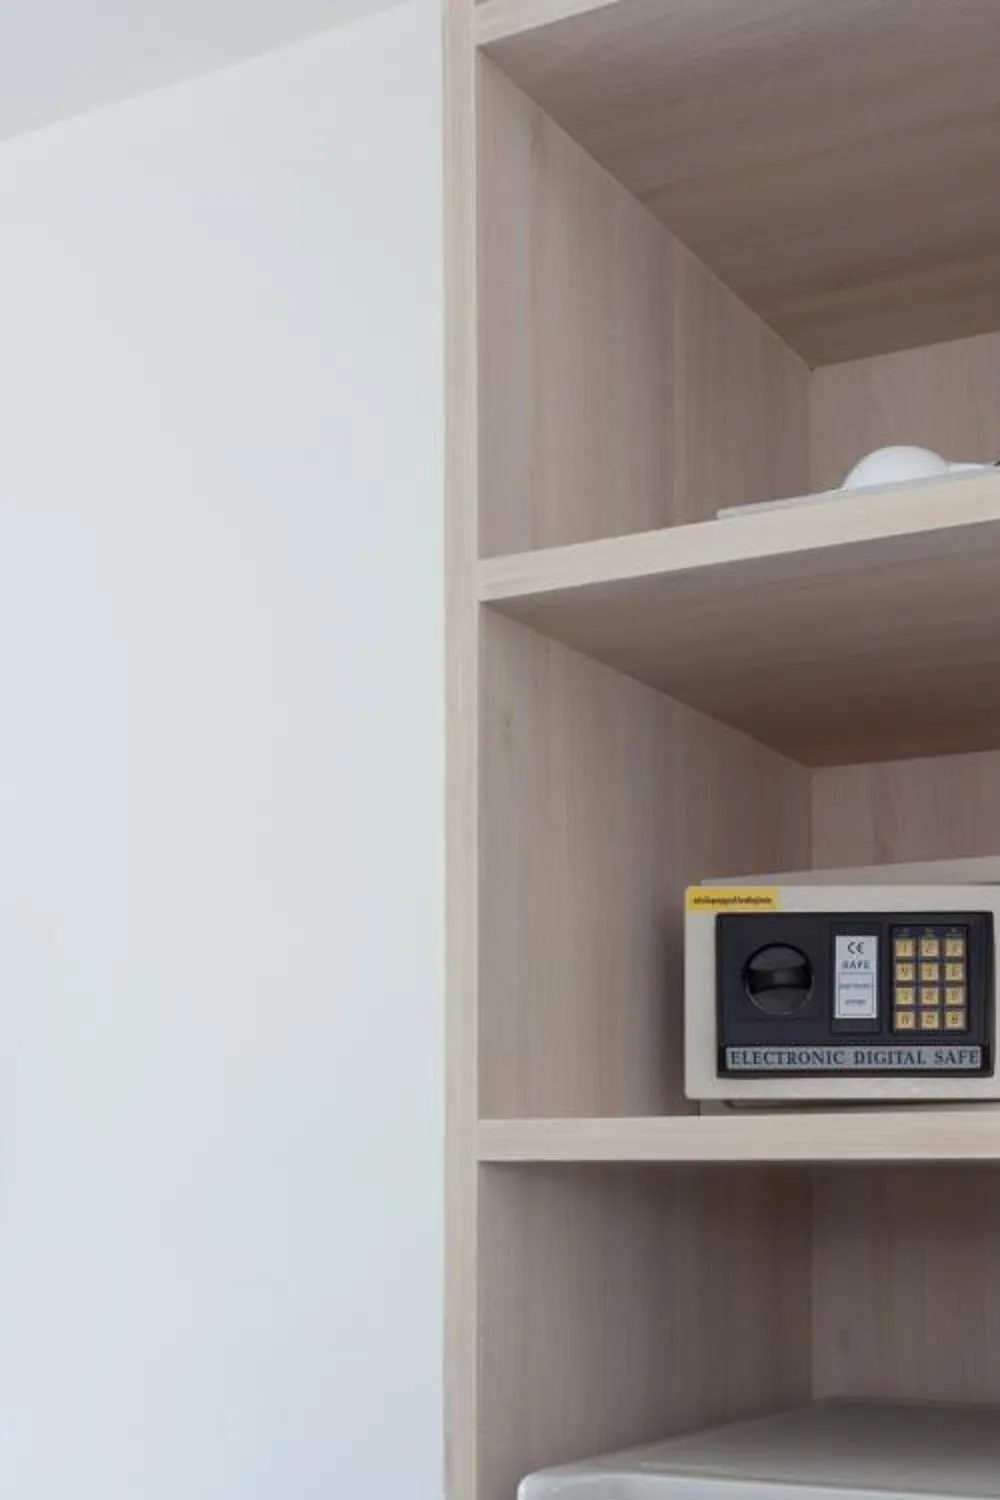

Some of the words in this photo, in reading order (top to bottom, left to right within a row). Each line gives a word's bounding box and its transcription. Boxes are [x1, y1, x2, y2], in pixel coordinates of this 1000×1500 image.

[847, 941, 865, 955] CE
[842, 960, 871, 970] SAFE
[730, 1050, 845, 1066] ELECTRONIC
[853, 1050, 926, 1066] DIGITAL
[933, 1049, 979, 1065] SAFE
